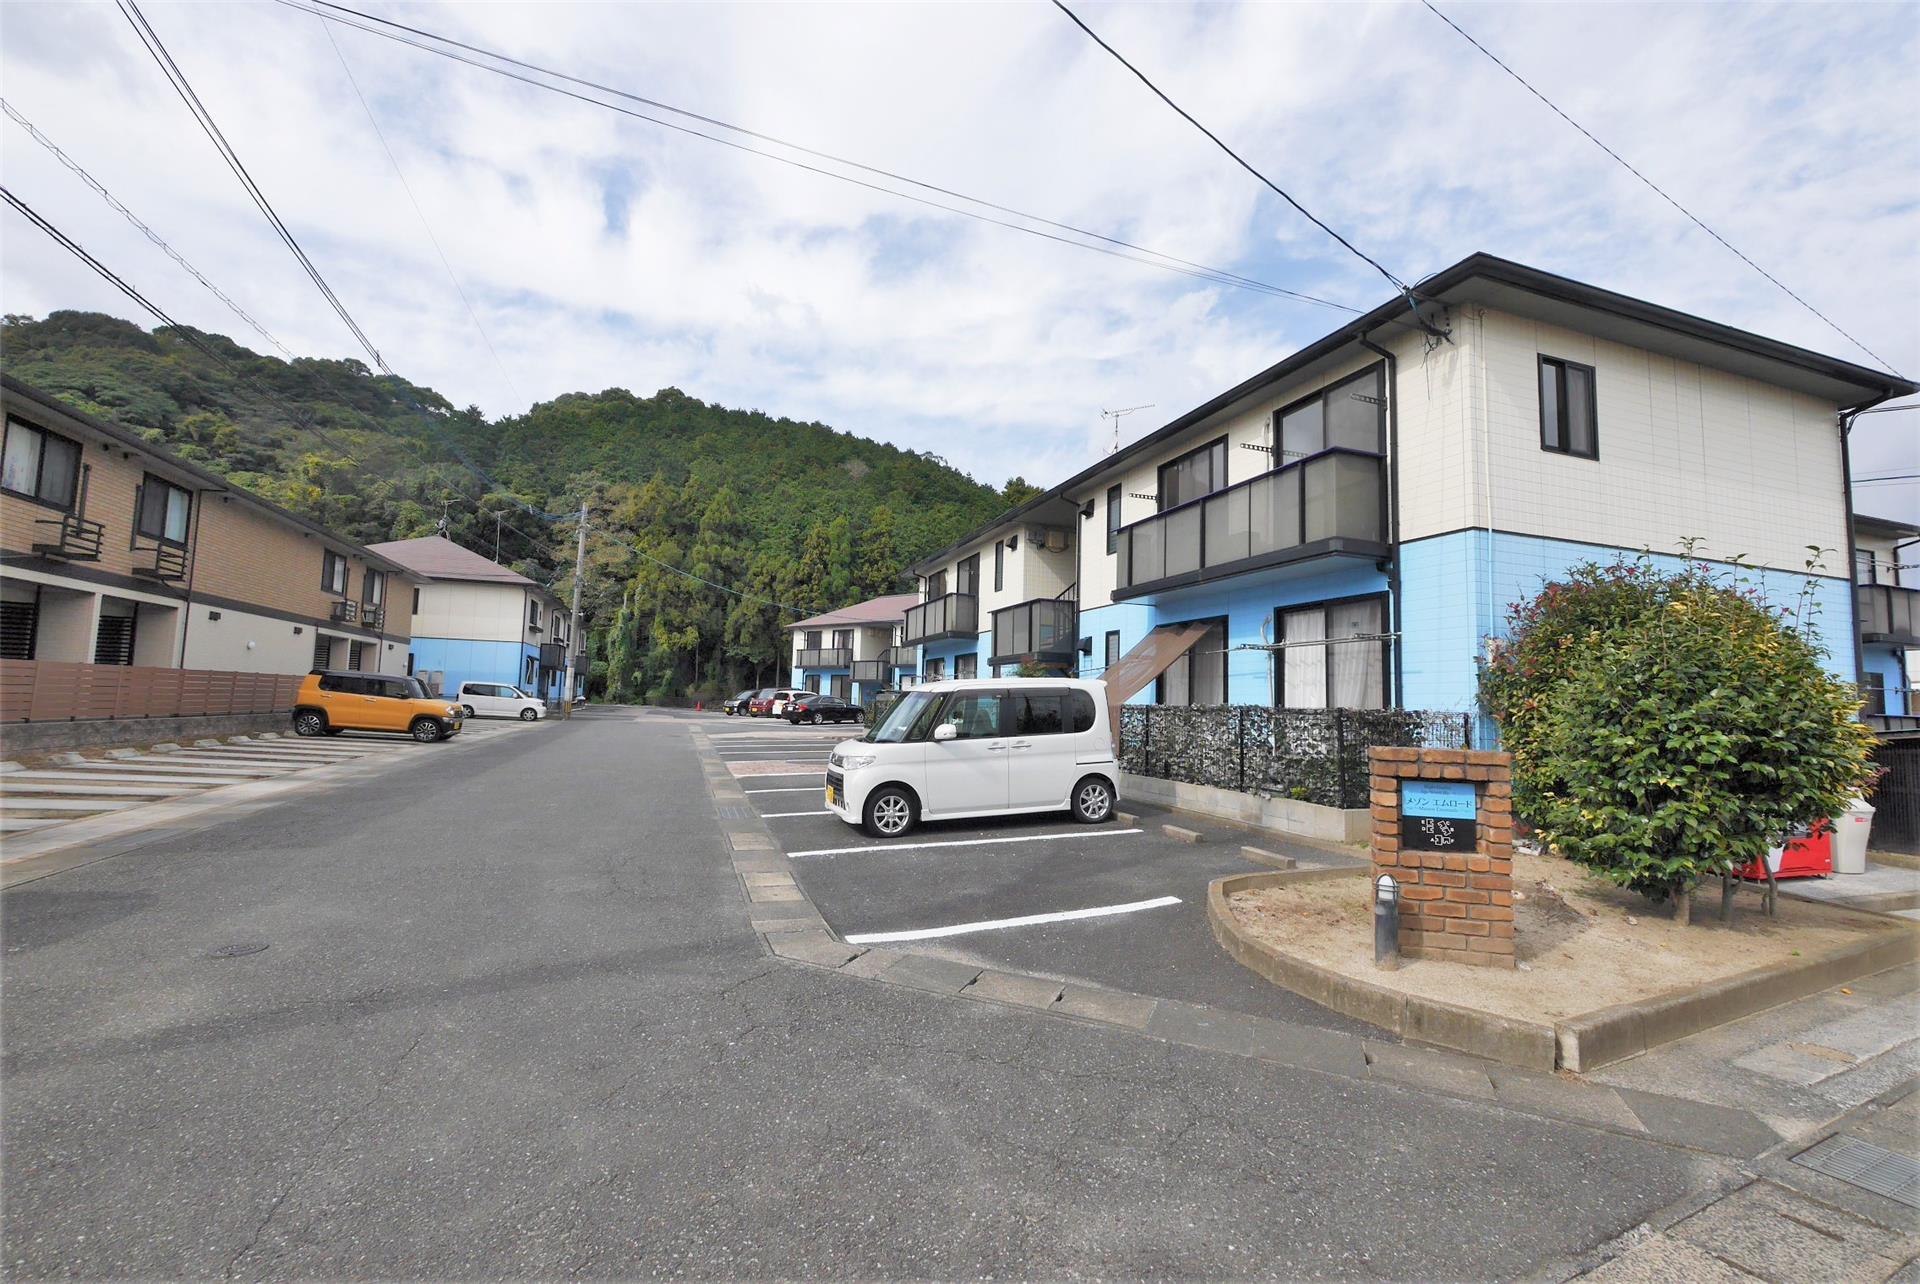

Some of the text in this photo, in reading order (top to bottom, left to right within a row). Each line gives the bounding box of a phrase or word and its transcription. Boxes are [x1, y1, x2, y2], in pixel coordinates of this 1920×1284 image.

[1407, 797, 1473, 808] メゾン エムロード
